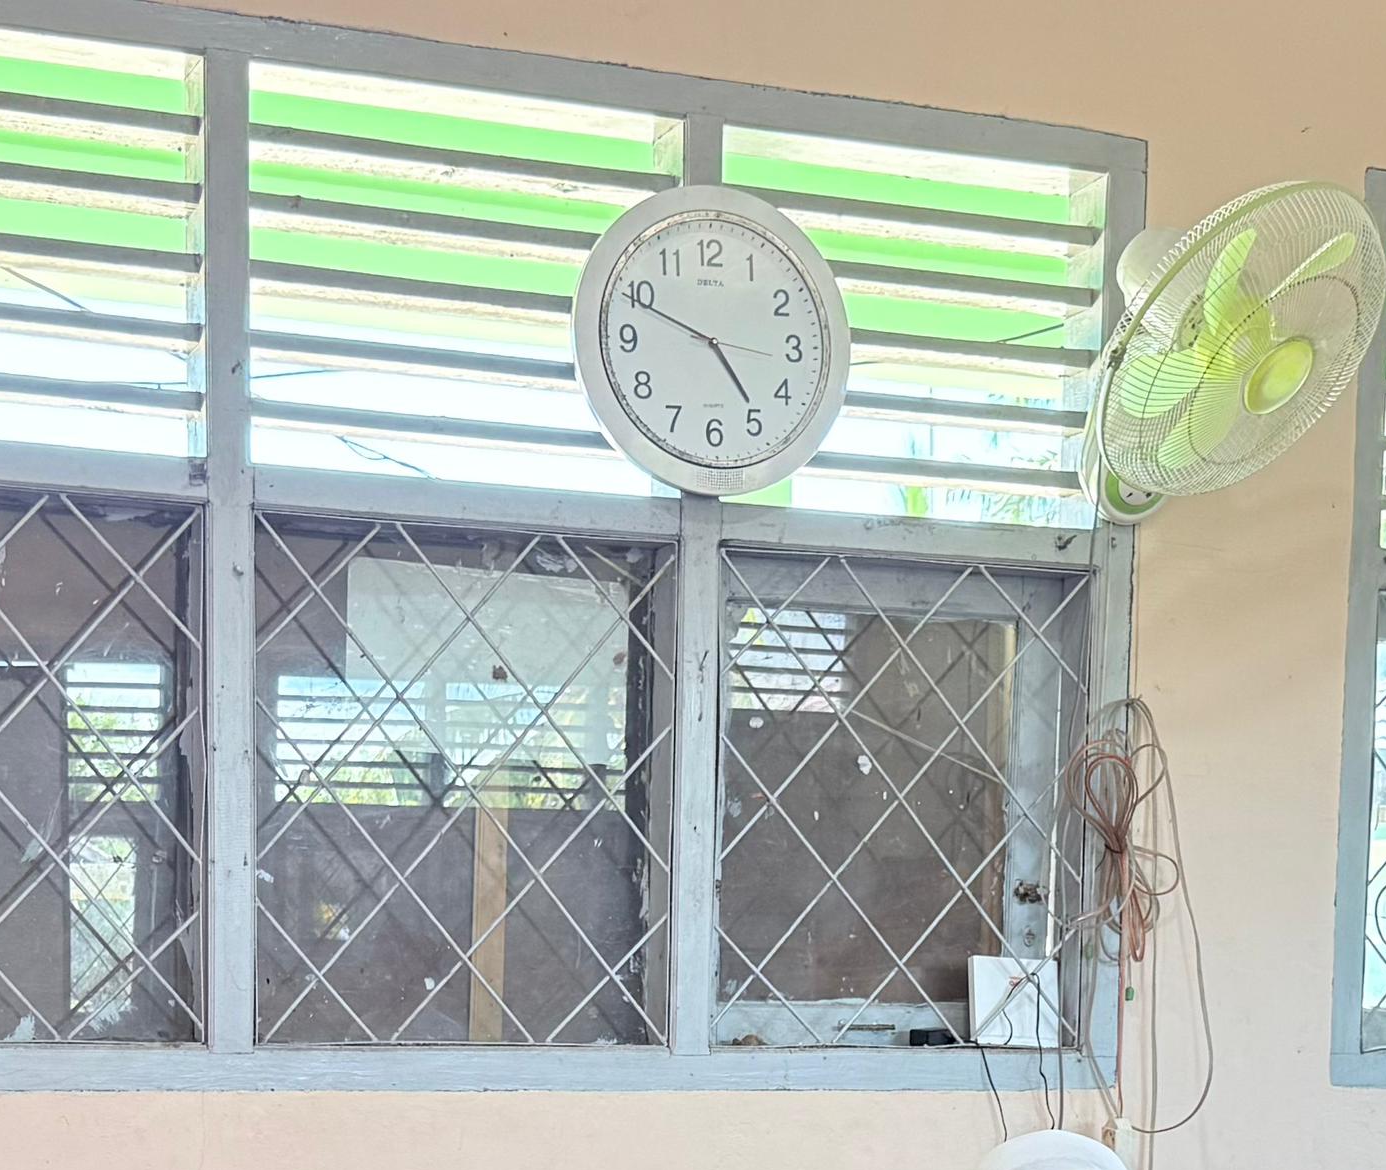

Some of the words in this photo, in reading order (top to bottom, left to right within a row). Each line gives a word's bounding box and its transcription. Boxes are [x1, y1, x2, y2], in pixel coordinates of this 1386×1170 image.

[659, 247, 681, 277] 11
[696, 239, 723, 267] 12
[745, 253, 754, 282] 1
[627, 280, 655, 309] 10
[773, 288, 790, 317] 2
[619, 323, 638, 353] 9
[785, 334, 803, 363] 3
[633, 370, 653, 399] 8
[774, 378, 792, 406] 4
[665, 404, 683, 433] 7
[705, 418, 724, 447] 6
[746, 408, 763, 437] 5
